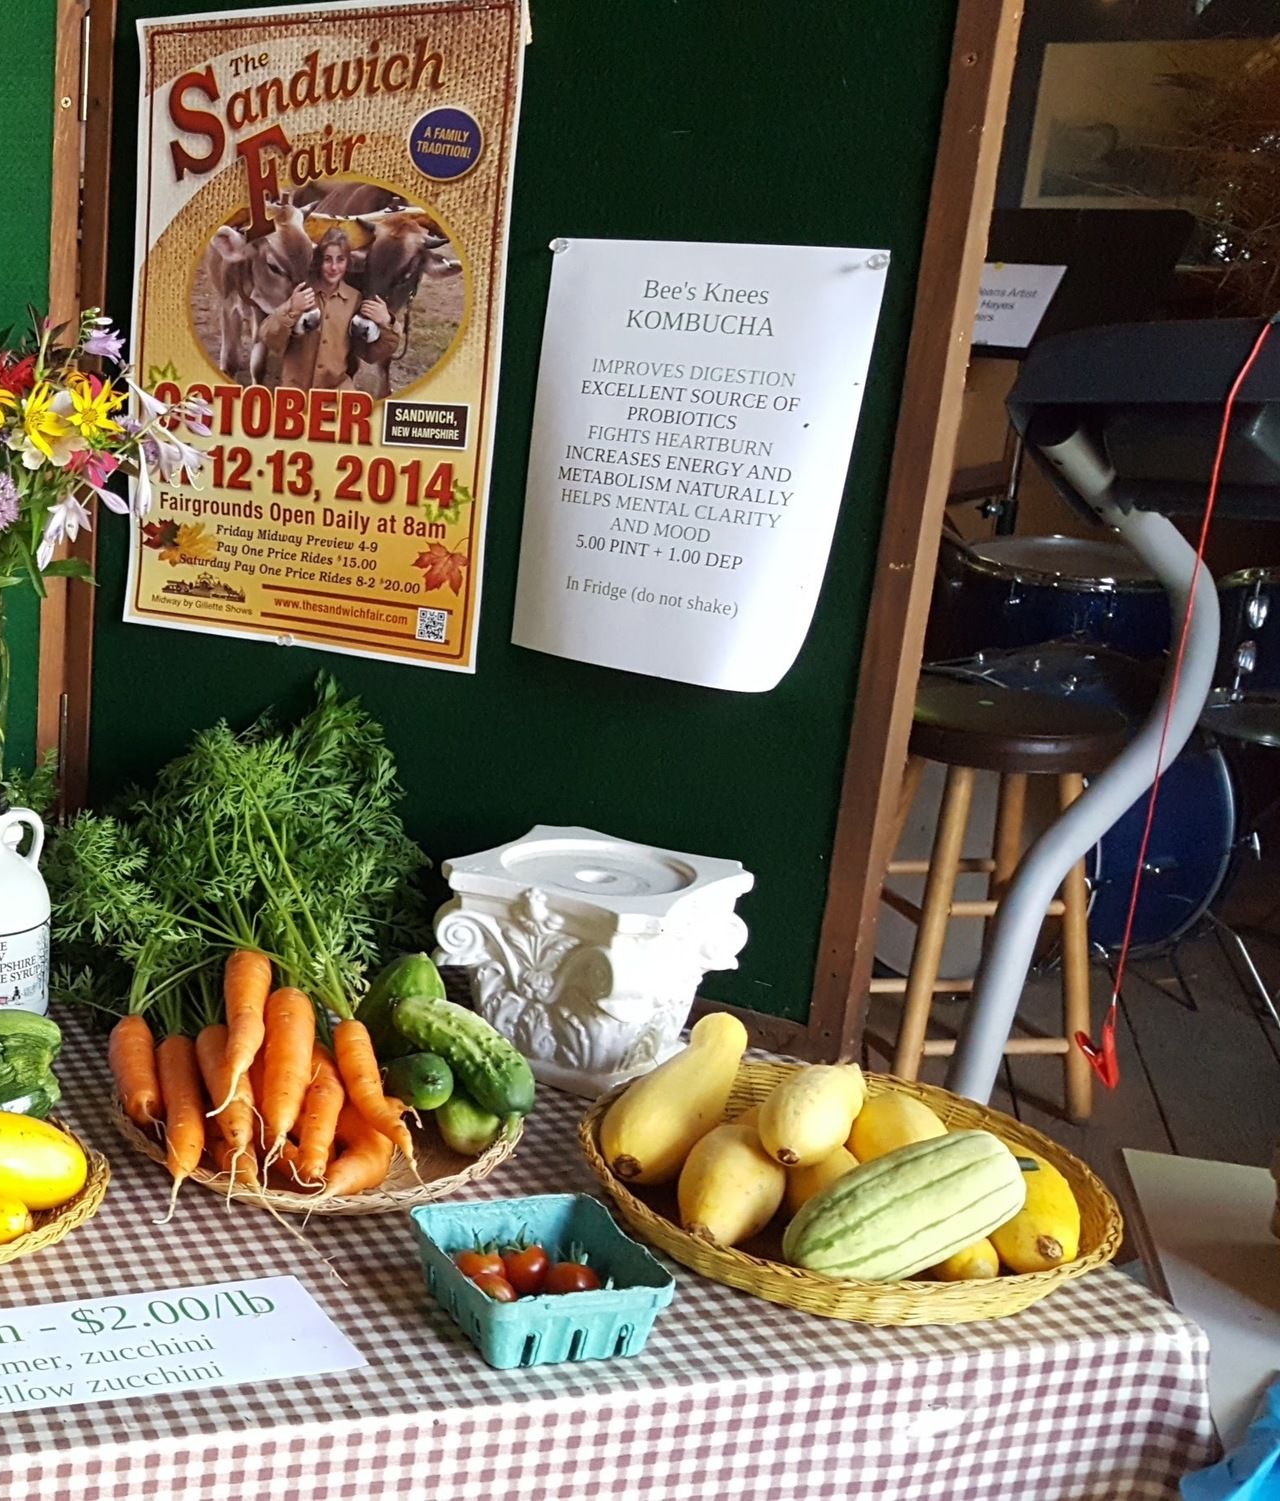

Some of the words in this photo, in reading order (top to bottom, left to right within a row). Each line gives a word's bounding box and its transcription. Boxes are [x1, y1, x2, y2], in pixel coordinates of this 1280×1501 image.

[230, 52, 270, 78] The
[168, 37, 446, 182] Sandwich
[416, 141, 472, 159] TRADITION!
[434, 127, 471, 142] FAMILY
[236, 124, 366, 241] Fair
[643, 279, 697, 301] Bee's
[703, 283, 770, 305] Knees
[626, 309, 775, 338] KOMBUCHA
[592, 358, 685, 380] IMPROVES
[689, 365, 797, 388] DIGESTION
[581, 380, 688, 403] EXCELLENT
[689, 388, 770, 411] SOURCE
[773, 396, 801, 413] OF
[154, 382, 374, 445] OCTOBER
[394, 409, 458, 425] SANDWICH,
[627, 406, 738, 430] PROBIOTICS
[411, 428, 460, 441] HAMPSHIRE
[587, 425, 651, 446] FIGHTS
[655, 431, 774, 457] HEARTBURN
[565, 445, 662, 469] INCREASES
[666, 456, 744, 479] ENERGY
[746, 465, 793, 484] AND
[334, 455, 455, 508] 2014
[558, 466, 673, 494] METABOLISM
[676, 479, 795, 507] NATURALLY
[159, 492, 264, 520] Fairgrounds
[269, 504, 315, 526] Open
[322, 510, 370, 535] Daily
[377, 515, 396, 533] at
[403, 517, 447, 539] 8am
[561, 488, 612, 508] HELPS
[615, 495, 690, 519] MENTAL
[694, 505, 782, 530] CLARITY
[216, 524, 254, 542] Friday
[257, 529, 303, 547] Midway
[306, 534, 355, 551] Preview
[358, 540, 378, 553] 4-9
[610, 517, 649, 535] AND
[653, 523, 711, 544] MOOD
[216, 541, 239, 557] Pay
[241, 544, 264, 557] One
[267, 546, 298, 562] Price
[300, 550, 334, 566] Rides
[576, 534, 606, 552] 5.00
[609, 539, 650, 558] PINT
[668, 547, 701, 565] 1.00
[705, 552, 744, 571] DEP
[179, 553, 231, 572] Saturday
[234, 560, 256, 576] Pay
[259, 563, 282, 577] One
[285, 566, 316, 581] Price
[319, 569, 352, 586] Rides
[355, 576, 376, 589] 8-2
[151, 594, 182, 609] Midway
[195, 598, 224, 612] Gillette
[225, 603, 253, 617] Shows
[274, 597, 408, 626] www.thesandwichfair.com
[566, 575, 581, 591] In
[583, 579, 628, 601] Fridge
[631, 586, 656, 605] (do
[659, 593, 683, 609] not
[686, 597, 739, 620] shake)
[71, 1289, 276, 1339] $2.00/lb
[80, 1333, 217, 1366] zucchini
[87, 1359, 225, 1395] zucchini
